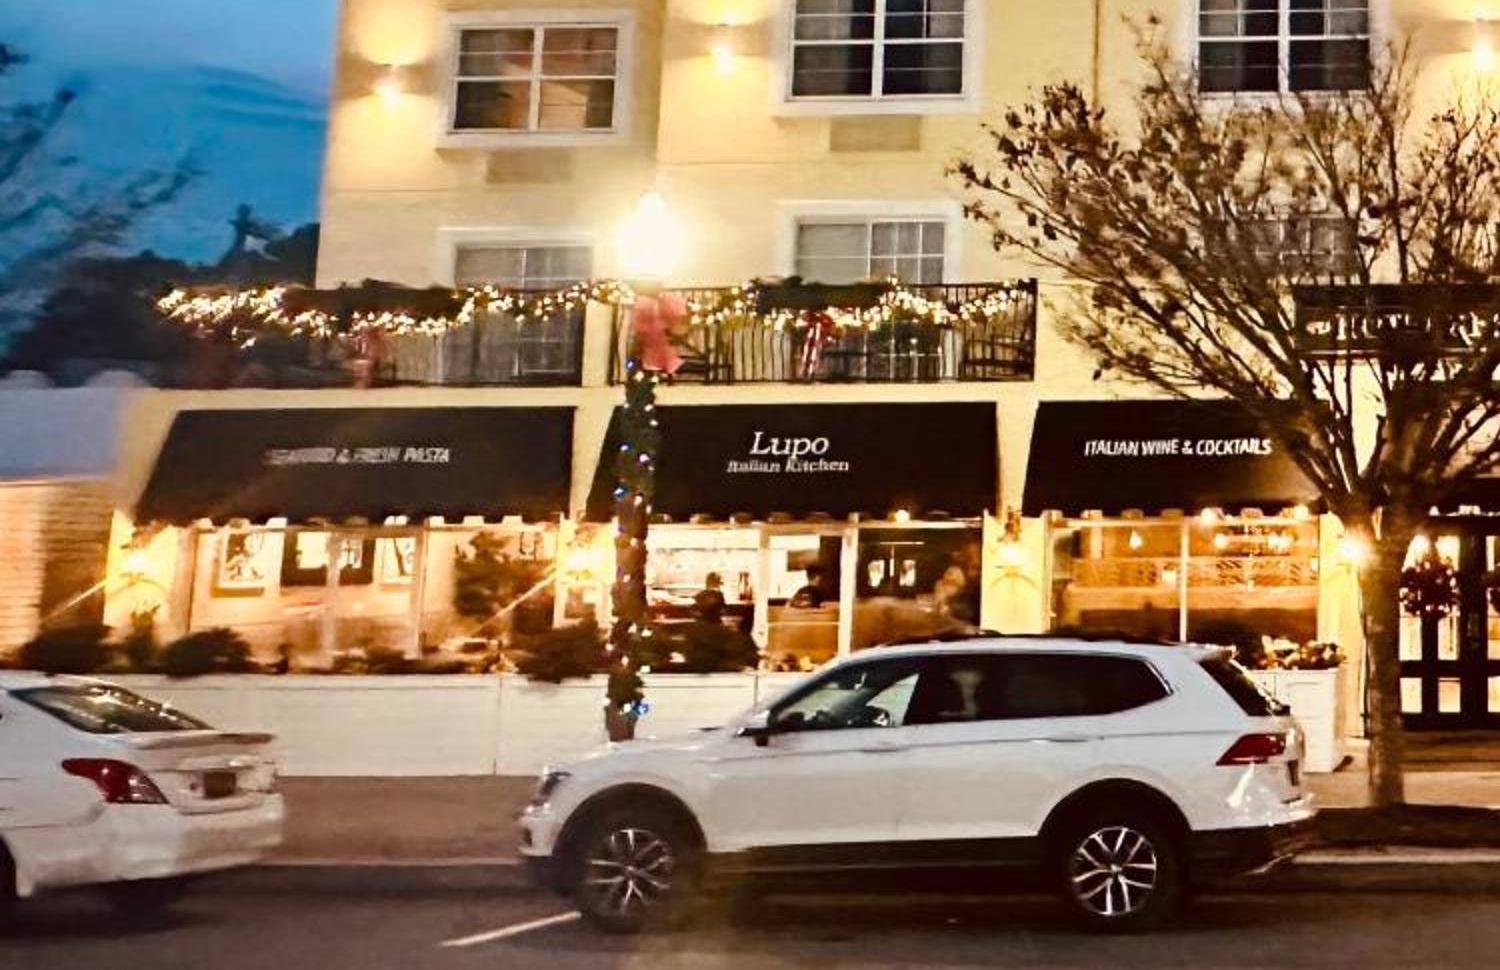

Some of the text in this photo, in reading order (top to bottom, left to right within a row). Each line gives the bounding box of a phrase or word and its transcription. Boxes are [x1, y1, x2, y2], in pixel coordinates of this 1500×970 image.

[749, 430, 830, 459] Lupo
[1084, 437, 1273, 457] ITALIAN WINE & COCKTAILS
[403, 446, 450, 463] PASTA
[726, 457, 849, 473] Italian Kitchen
